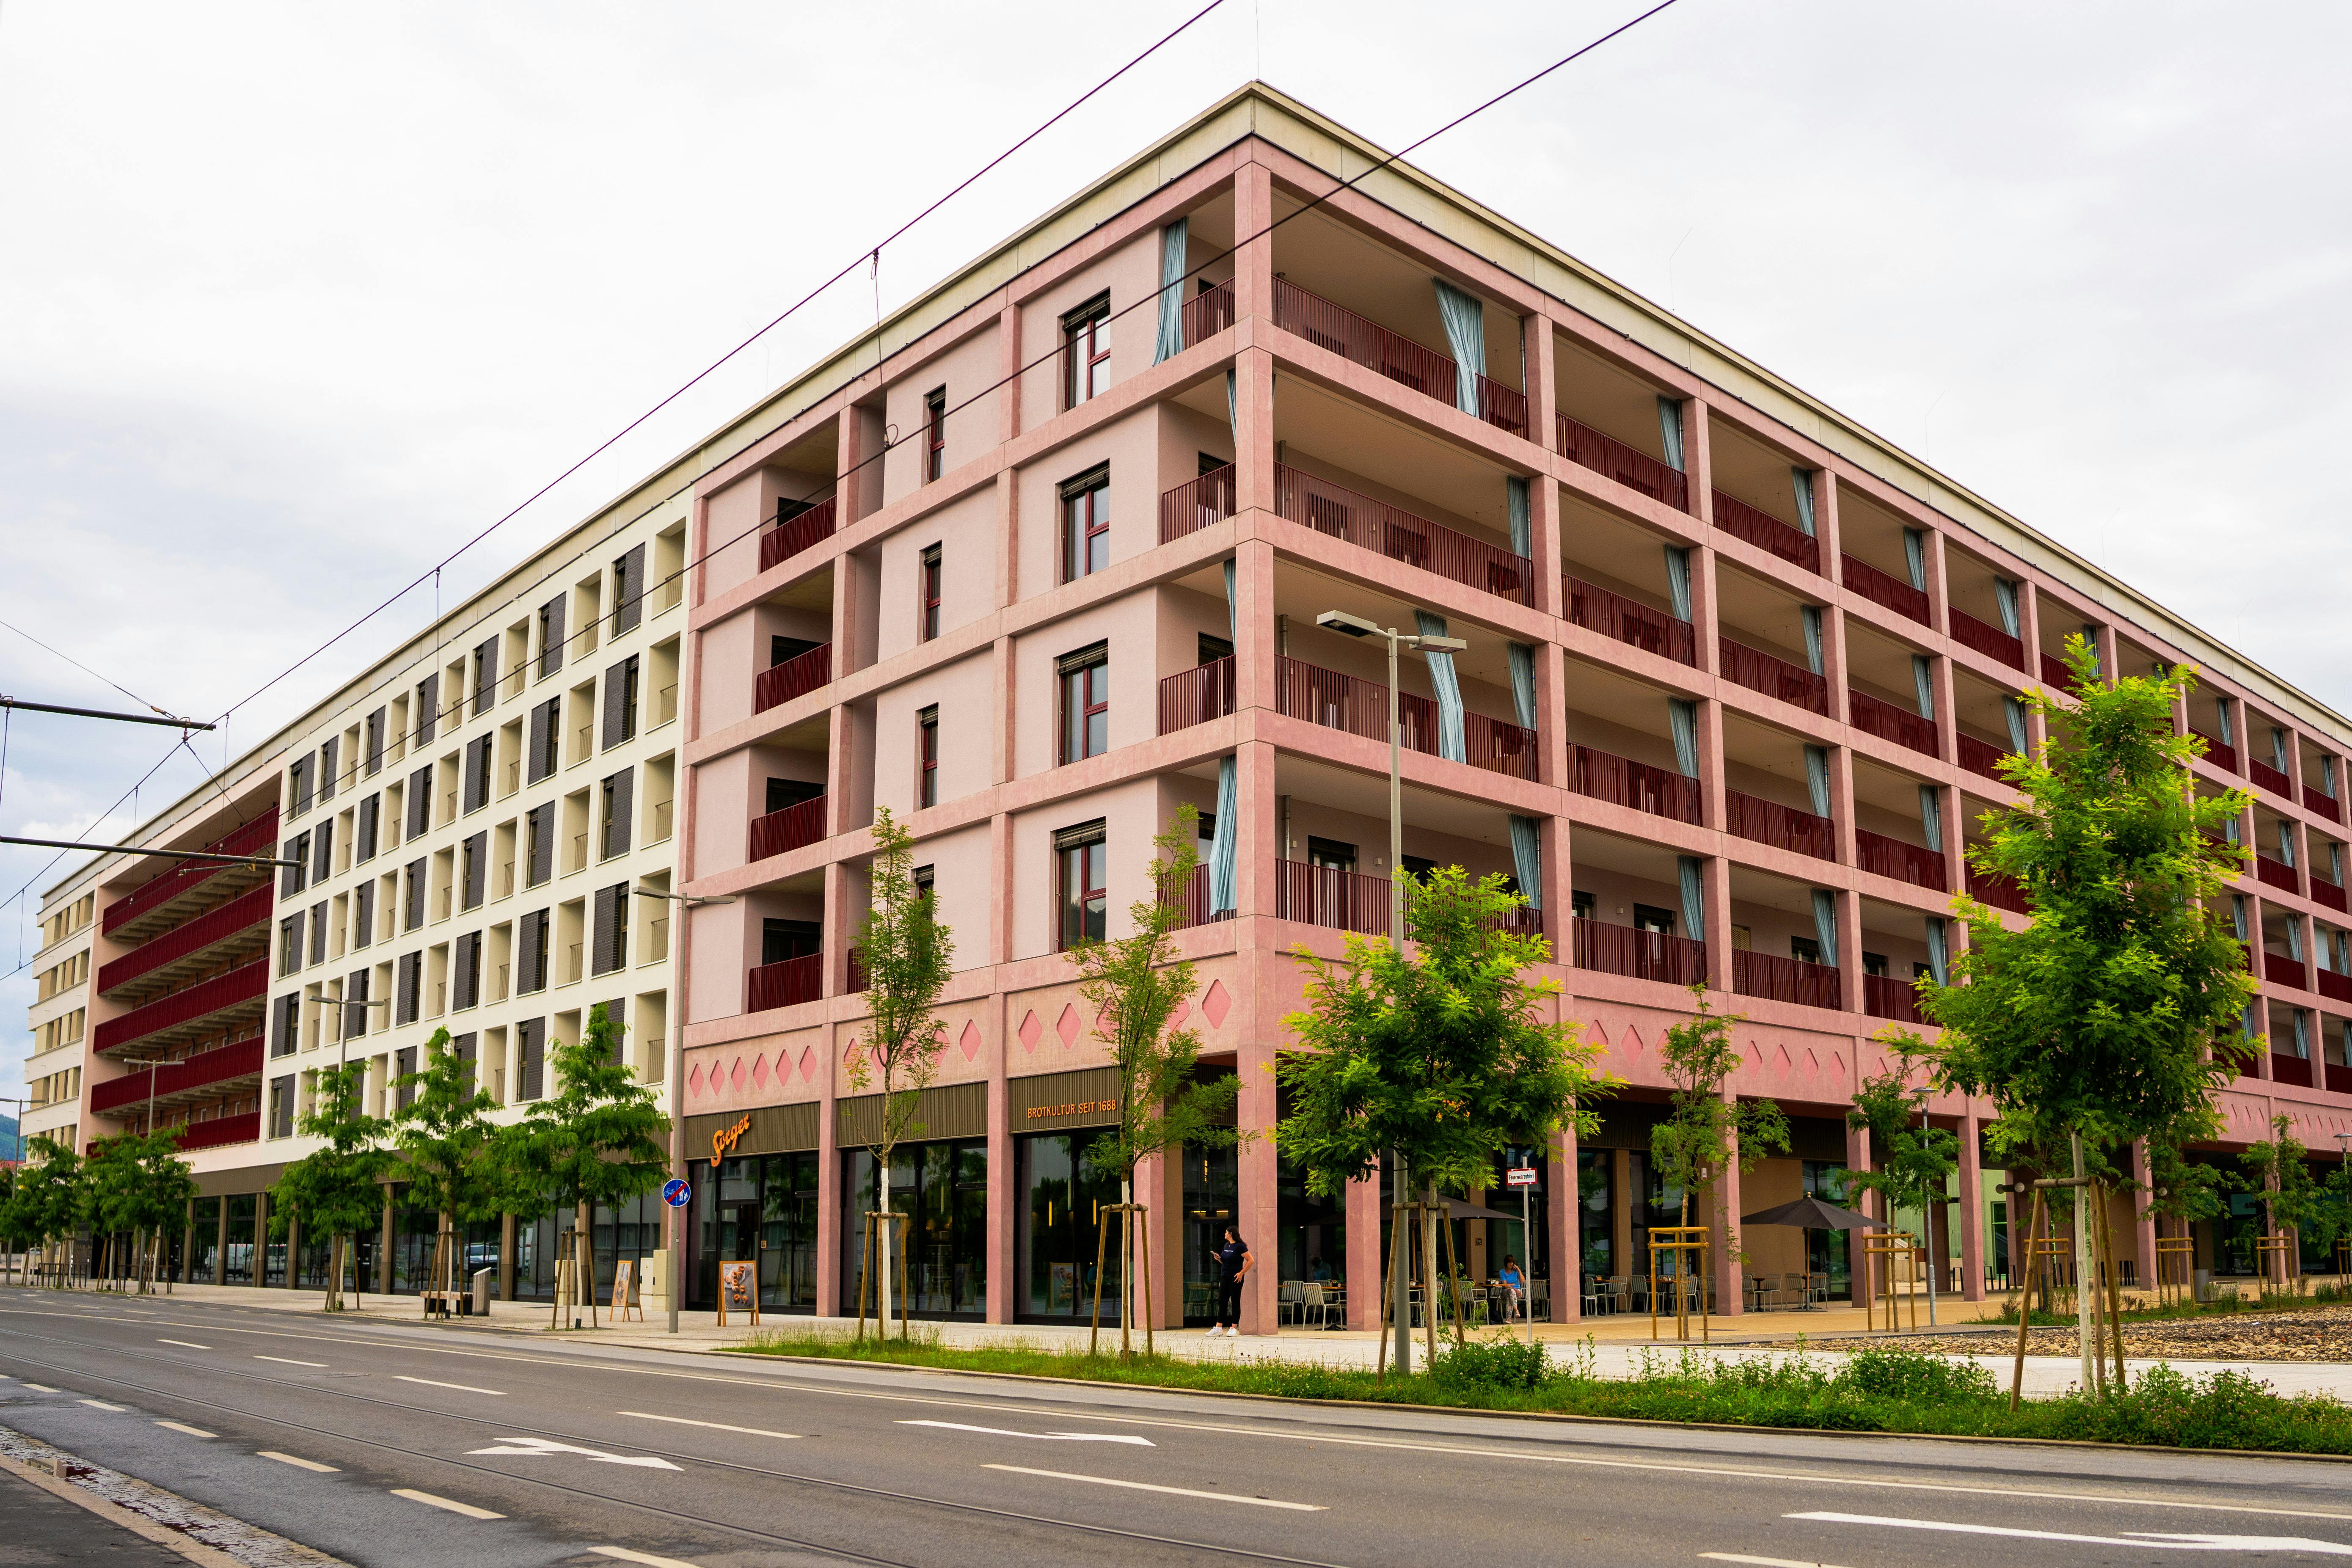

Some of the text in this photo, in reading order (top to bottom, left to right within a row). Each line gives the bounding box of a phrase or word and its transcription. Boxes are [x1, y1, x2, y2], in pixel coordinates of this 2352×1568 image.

[1027, 1100, 1116, 1118] BROTKULTUR SEIT 1688
